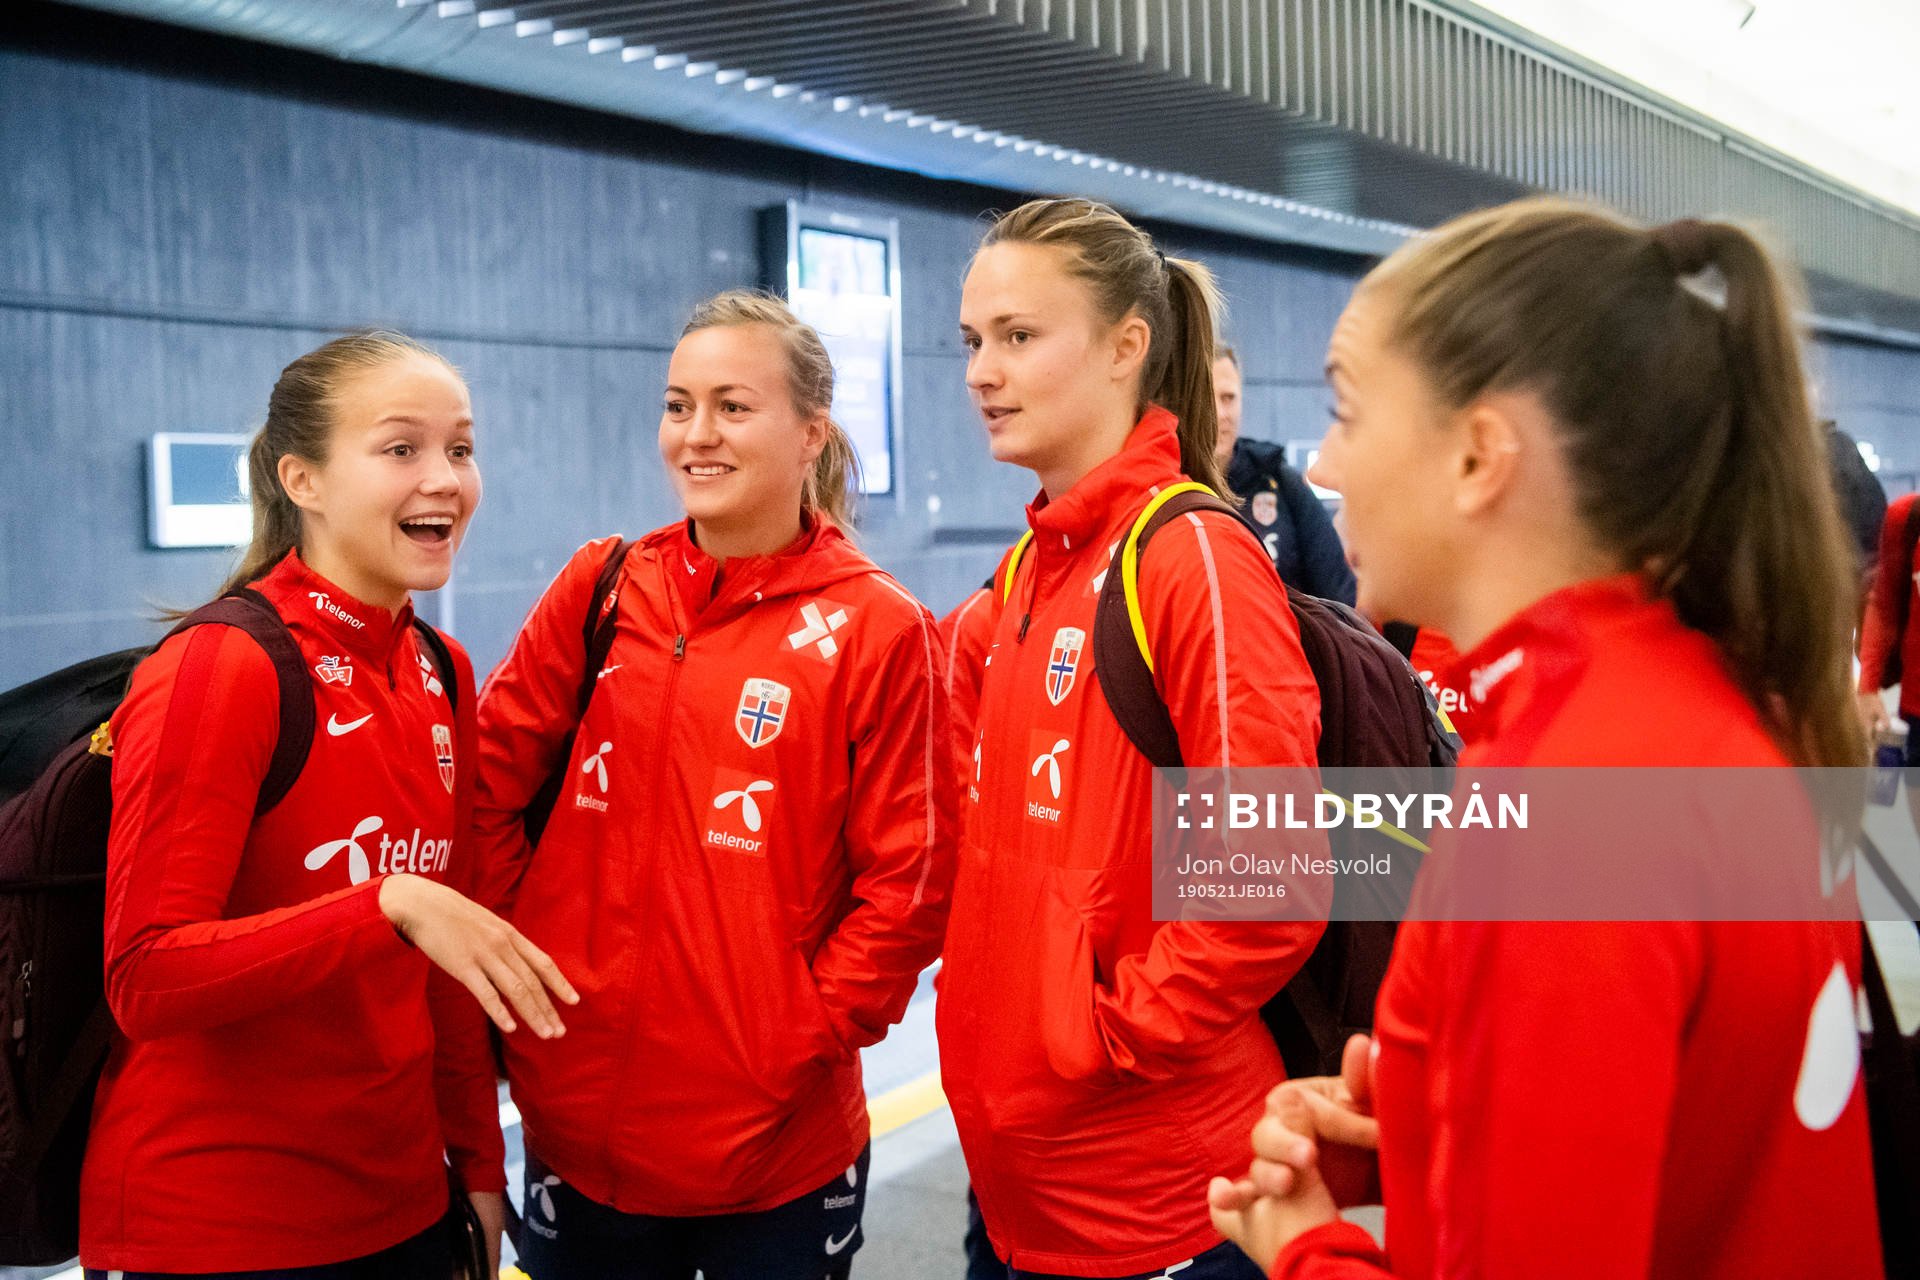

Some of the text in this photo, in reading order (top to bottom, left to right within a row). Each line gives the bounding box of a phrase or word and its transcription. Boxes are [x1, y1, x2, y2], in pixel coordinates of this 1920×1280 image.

[324, 599, 366, 631] telenor
[1430, 681, 1474, 713] tel
[576, 793, 609, 812] telenor
[1028, 801, 1061, 822] telenor
[378, 828, 453, 874] telen
[707, 829, 763, 852] telenor
